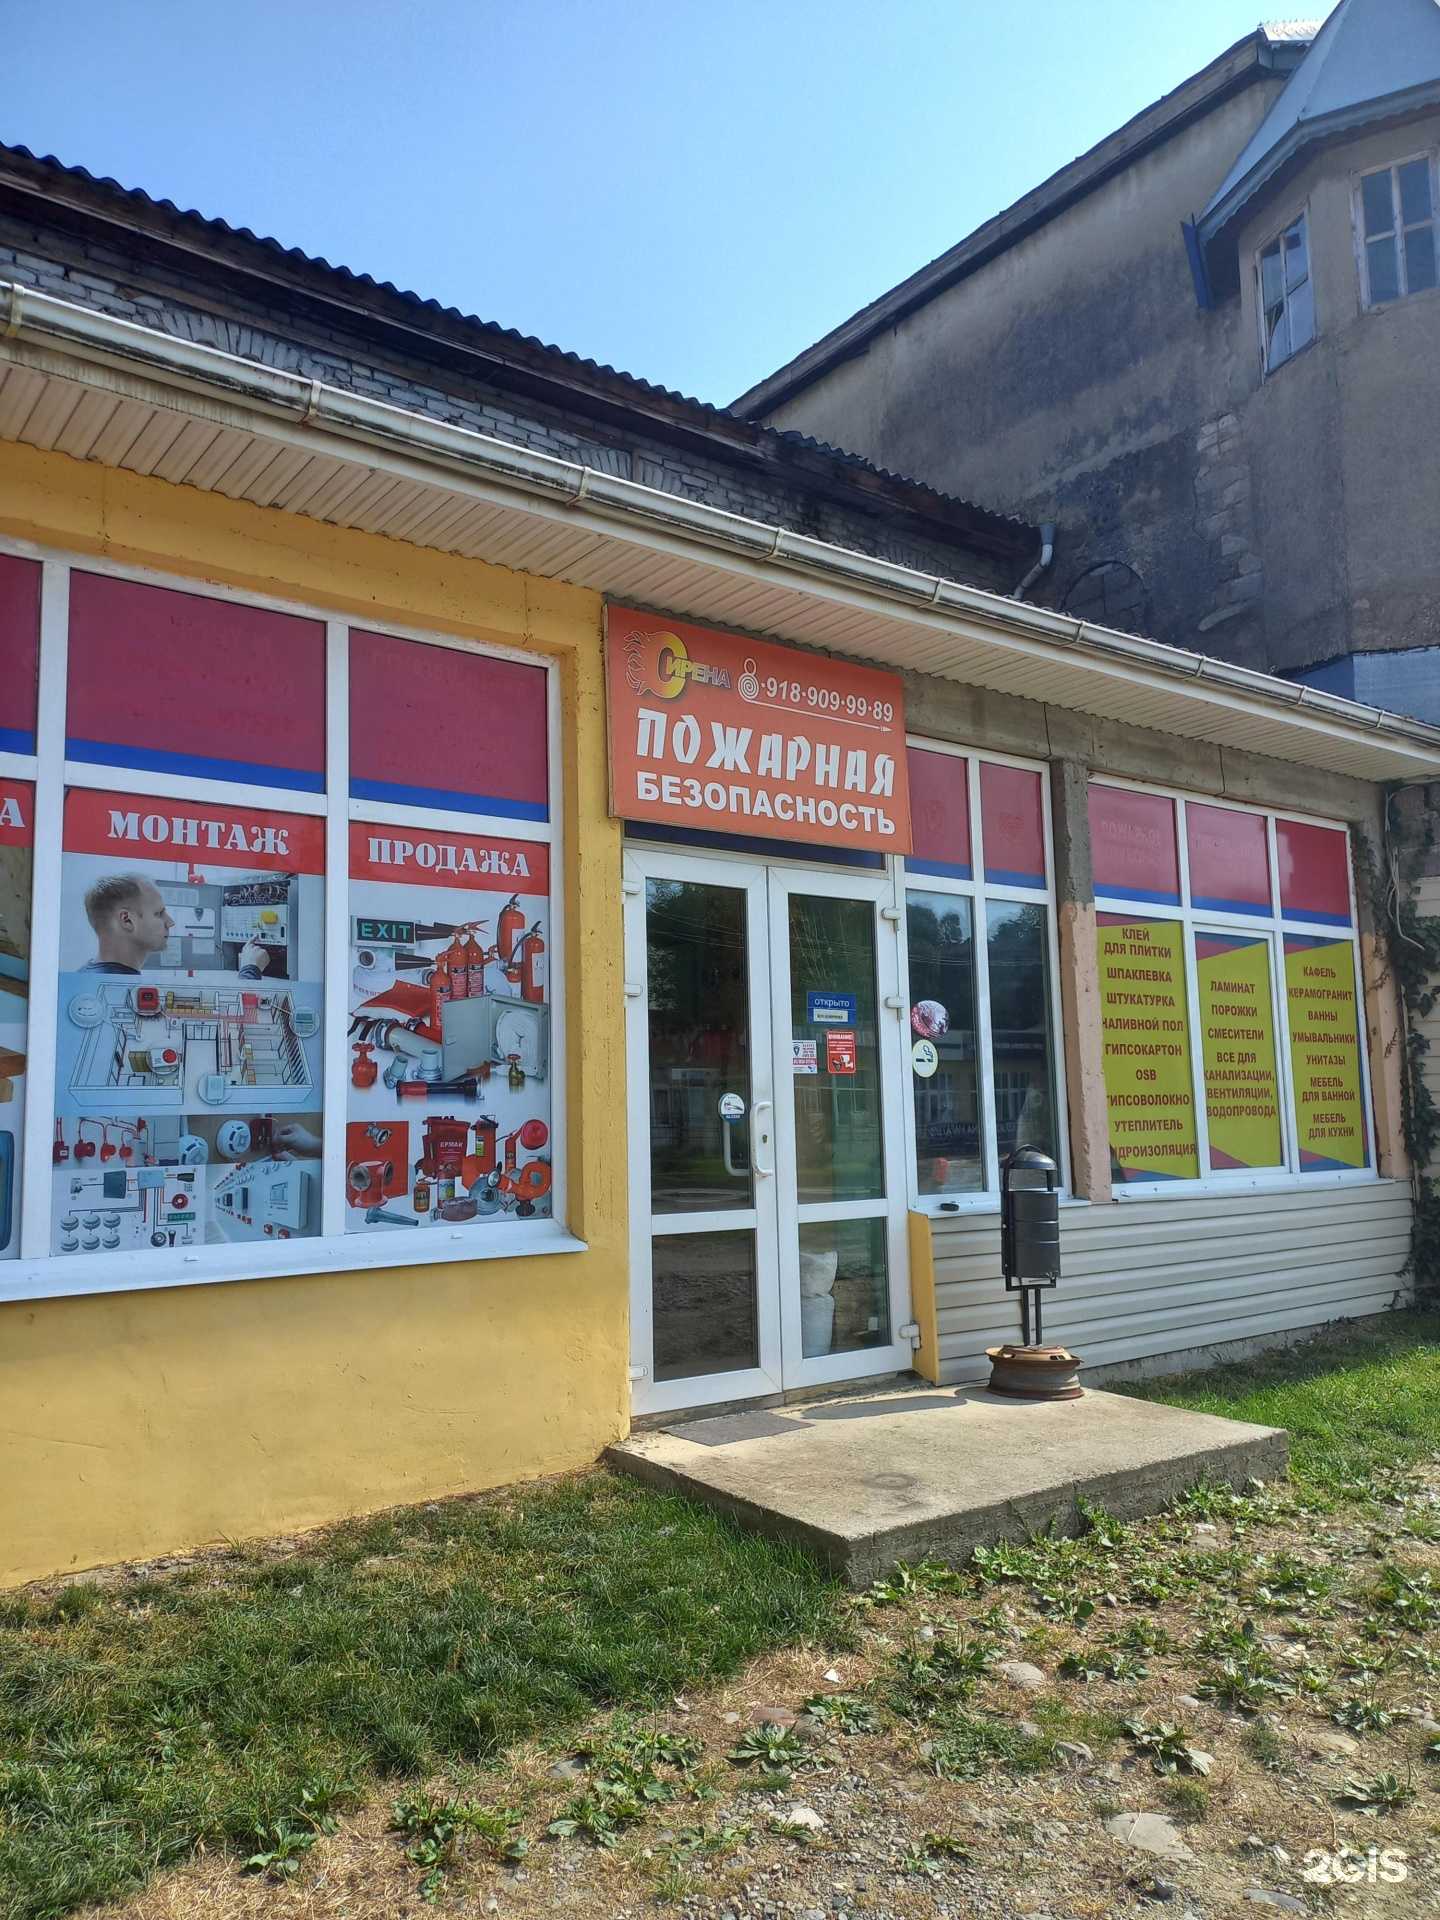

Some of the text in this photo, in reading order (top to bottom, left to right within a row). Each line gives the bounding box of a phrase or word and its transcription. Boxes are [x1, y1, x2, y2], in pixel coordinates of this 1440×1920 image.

[636, 708, 895, 797] ПОЖАРНАЯ
[636, 770, 896, 835] БЕЗОПАСНОСТЬ
[106, 810, 291, 856] МОНТАЖ
[367, 836, 531, 877] ПРОДАЖА
[361, 922, 411, 940] EXIT
[1122, 928, 1150, 941] КЛЕЙ
[1104, 942, 1172, 958] ДЛЯ ПЛИТКИ
[1107, 967, 1172, 983] ШПАКЛЕВКА
[1303, 966, 1336, 978] КАФЕЛЬ
[1210, 981, 1256, 994] ЛАМИНАТ
[1288, 987, 1352, 1001] КЕРАМОГРАНИТ
[1106, 992, 1175, 1007] ШТУКАТУРКА
[1211, 1004, 1257, 1017] ПОРОЖКИ
[1308, 1010, 1338, 1021] ВАННЫ
[1162, 1020, 1184, 1032] ПОЛ
[1208, 1027, 1264, 1040] СМЕСИТЕЛИ
[1292, 1031, 1356, 1044] УМЫВАЛЬНИКИ
[1105, 1043, 1182, 1056] ГИПСОКАРТОН
[1217, 1052, 1257, 1065] ВСЕ ДЛЯ
[1306, 1055, 1346, 1065] УНИТАЗЫ
[1136, 1069, 1157, 1081] OSB
[1310, 1077, 1344, 1088] МЕБЕЛЬ
[1302, 1089, 1355, 1103] ДЛЯ ВАННОЙ
[1207, 1105, 1276, 1119] ВОДОПРОВОДА
[1312, 1113, 1346, 1124] МЕБЕЛЬ
[1114, 1119, 1184, 1132] УТЕПЛИТЕЛЬ
[1309, 1126, 1354, 1140] ДЛЯ КУХНИ
[1115, 1143, 1196, 1160] ДРОИЗОЛЯЦИЯ
